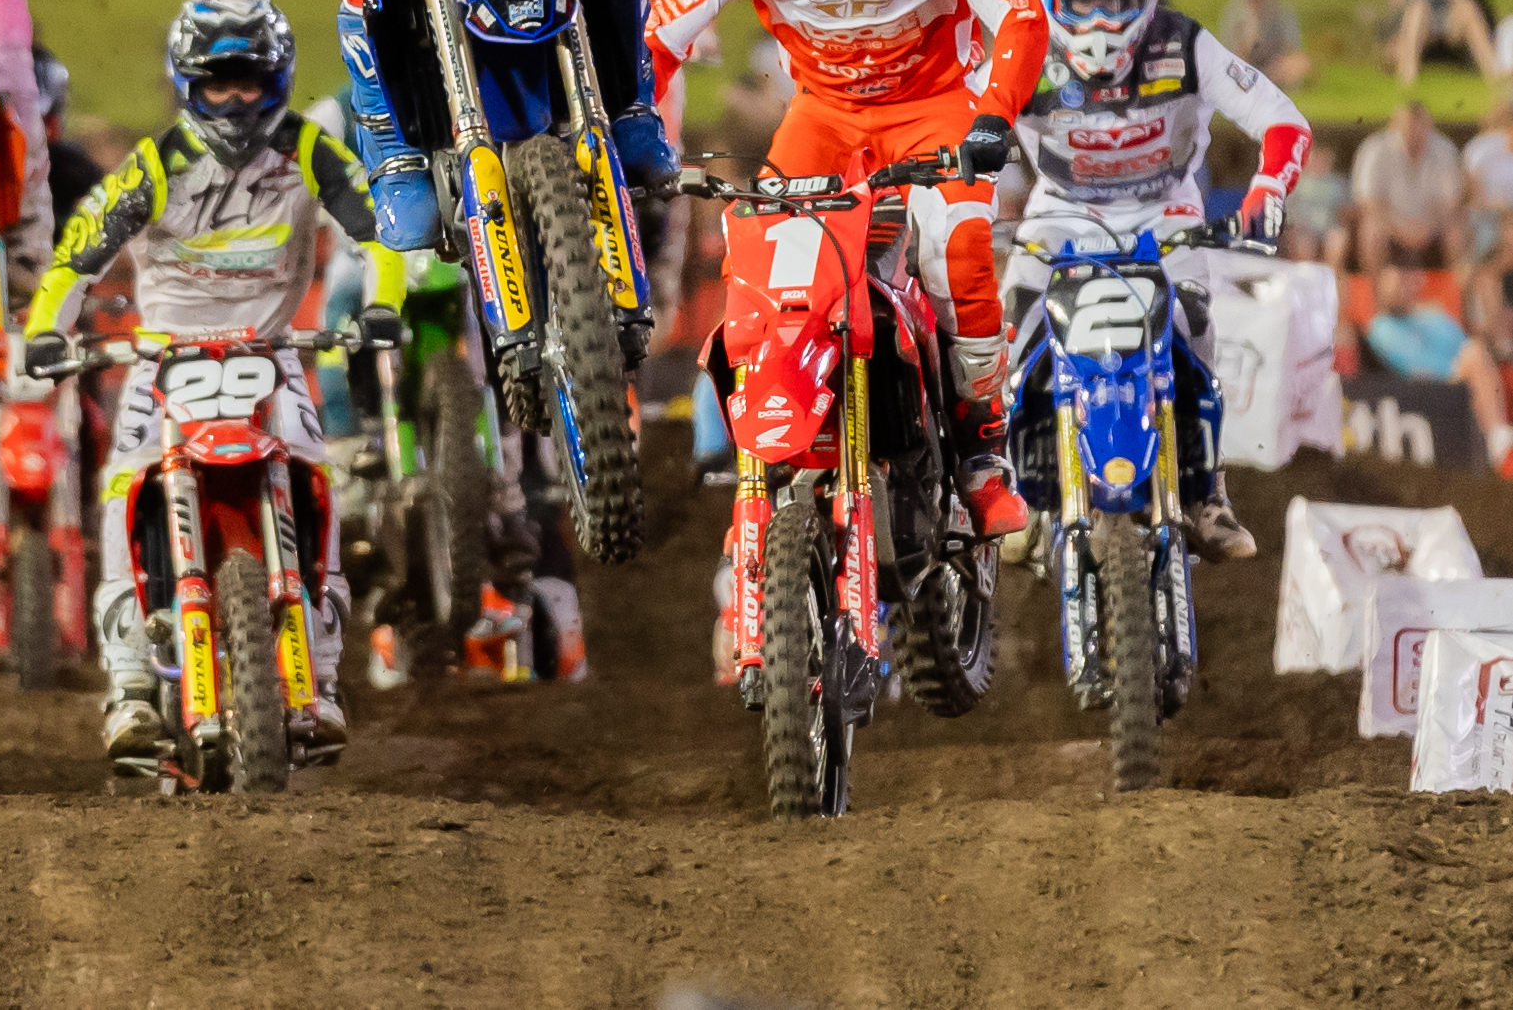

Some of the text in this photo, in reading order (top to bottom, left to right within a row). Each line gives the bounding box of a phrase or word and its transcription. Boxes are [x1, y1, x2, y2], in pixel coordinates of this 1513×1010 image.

[469, 217, 494, 301] BRAKING
[765, 215, 827, 290] 1
[1065, 276, 1156, 354] 2
[165, 356, 276, 424] 29
